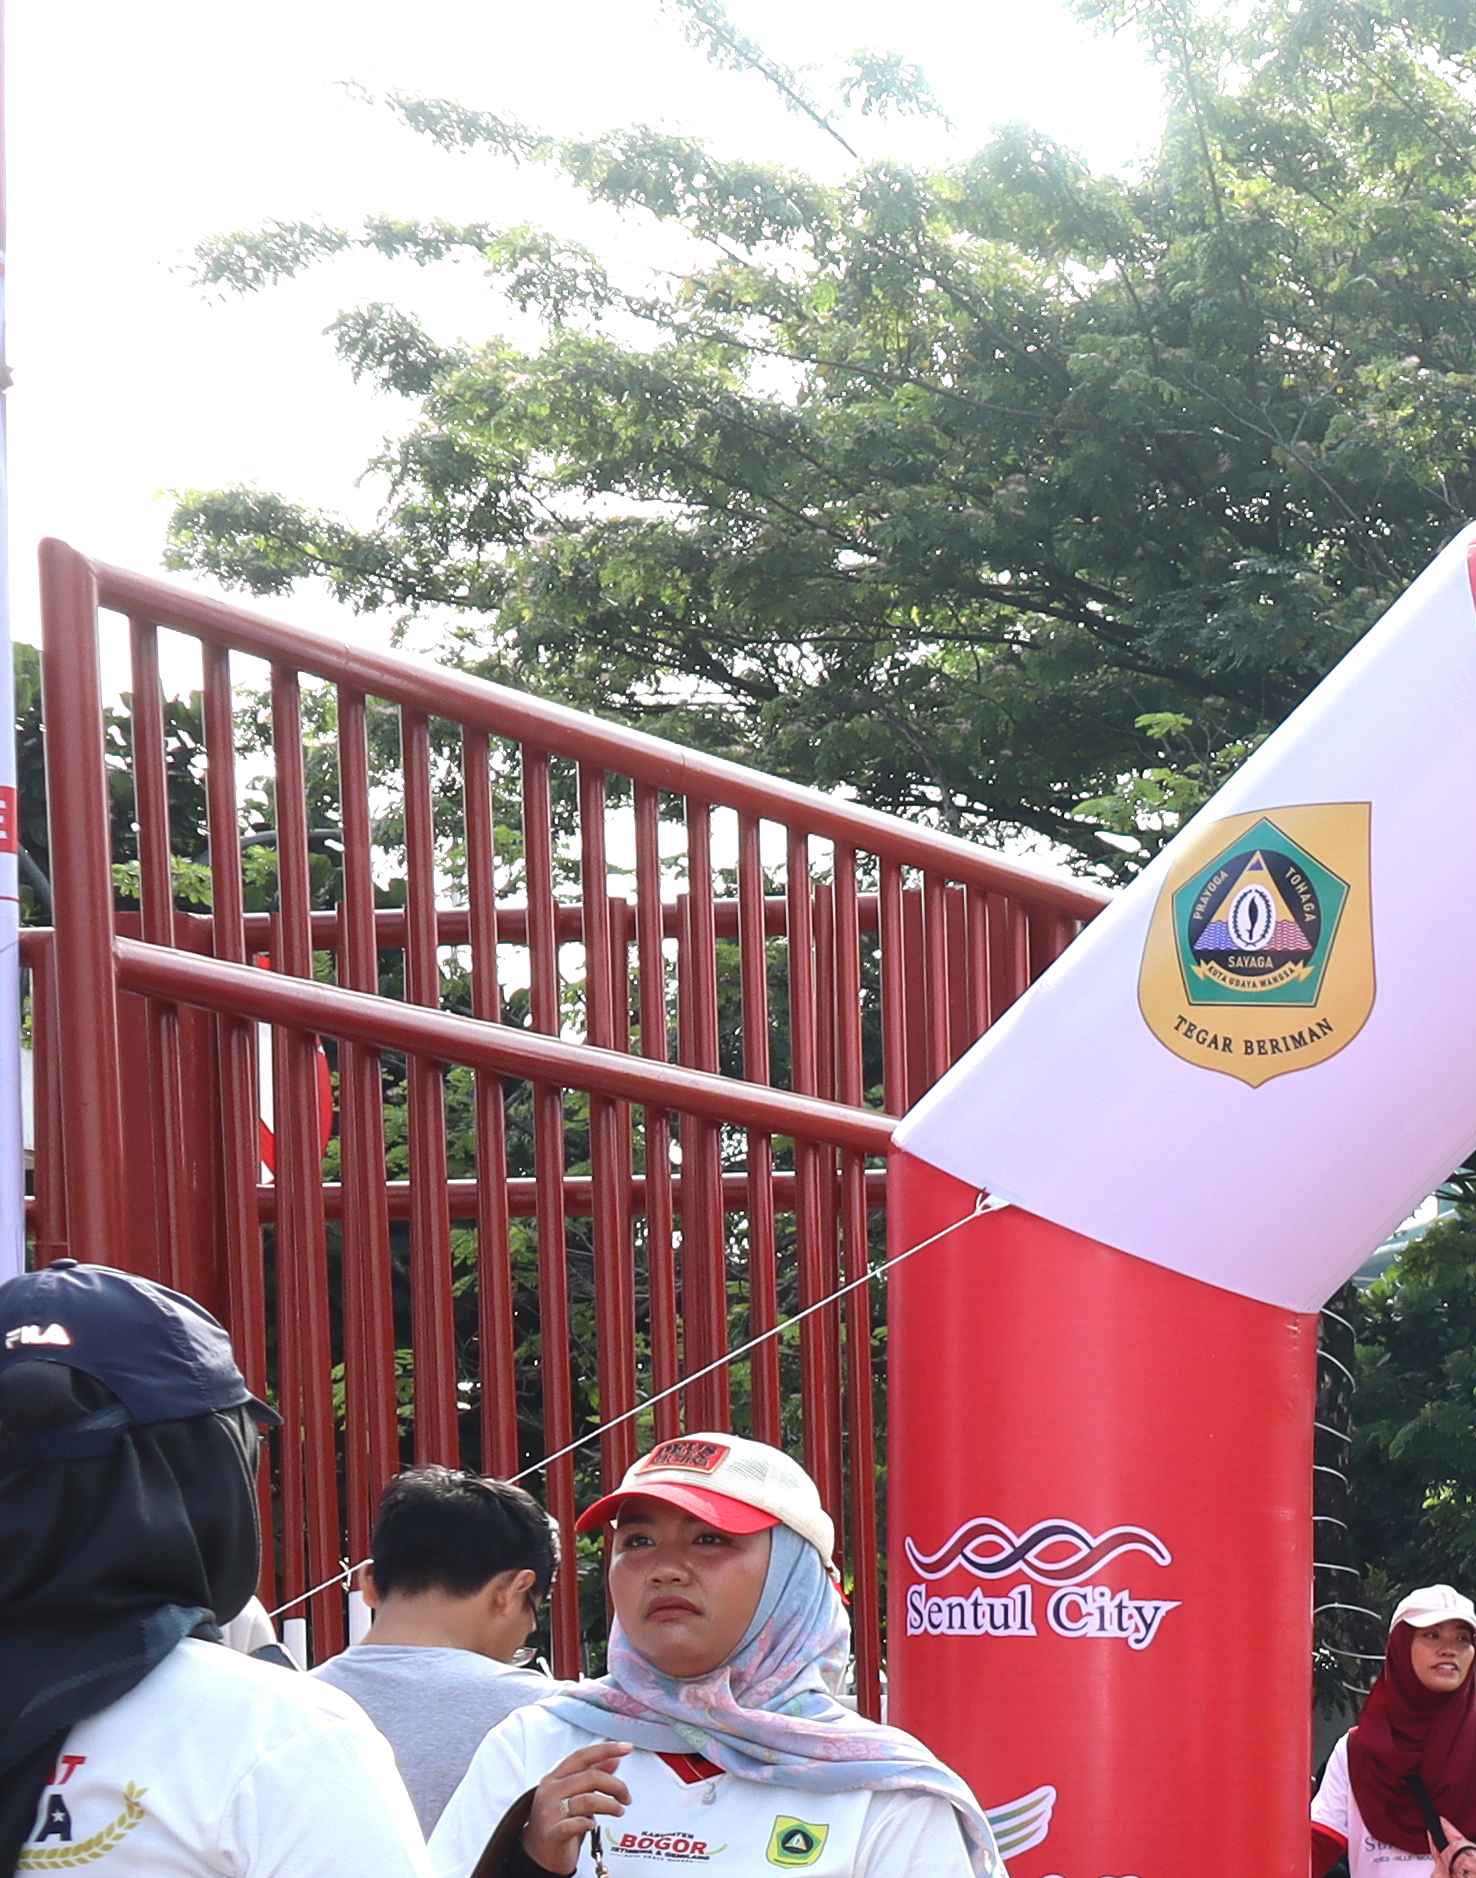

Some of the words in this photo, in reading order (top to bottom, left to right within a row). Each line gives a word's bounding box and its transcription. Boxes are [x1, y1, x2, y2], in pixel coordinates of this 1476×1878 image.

[1193, 869, 1229, 920] PRAYOGA
[1285, 867, 1317, 922] TOHAGA
[1207, 965, 1228, 983] KUTA
[1228, 955, 1274, 969] SAYAGA
[1173, 1015, 1234, 1054] TEGAR
[1243, 1017, 1334, 1056] BERIMAN
[908, 1588, 1033, 1632] Sentul
[1053, 1591, 1166, 1645] City
[619, 1833, 708, 1855] BOGOR
